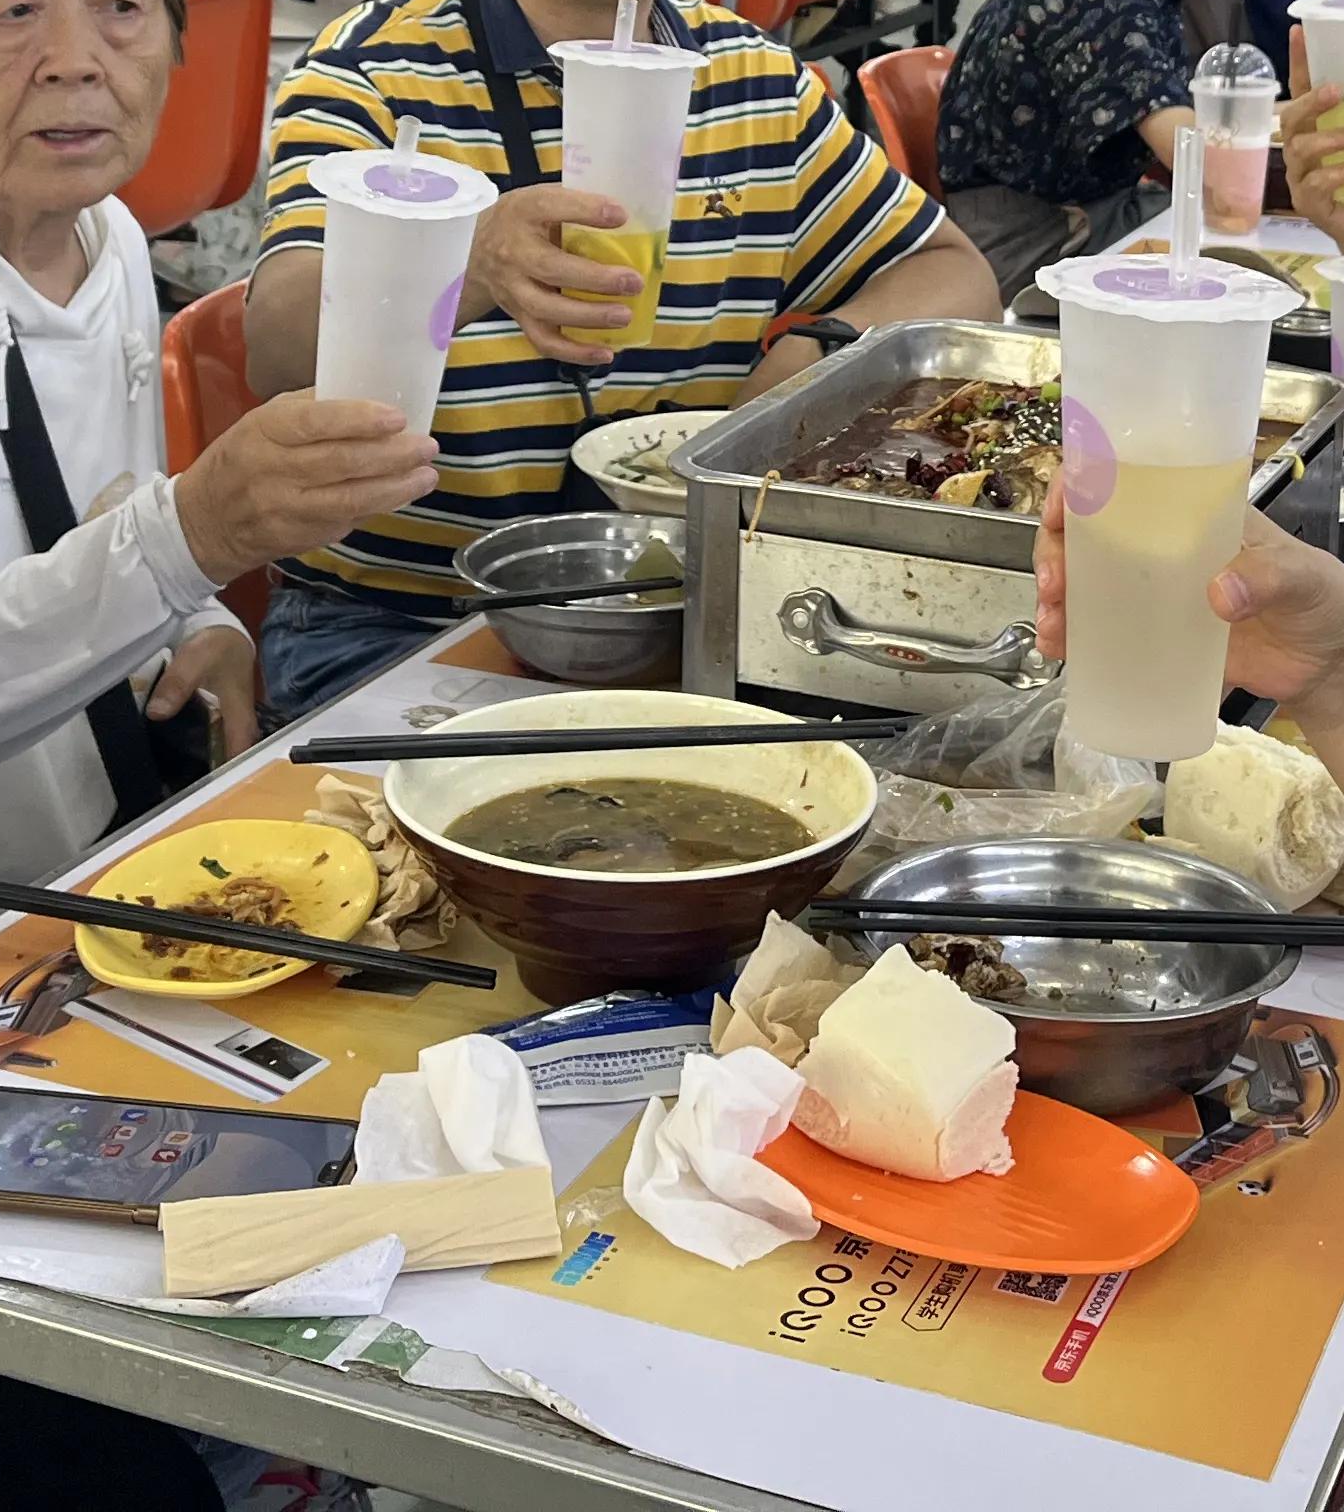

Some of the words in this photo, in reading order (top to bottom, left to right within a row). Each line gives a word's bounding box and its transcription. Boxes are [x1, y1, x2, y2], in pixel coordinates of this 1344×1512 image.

[643, 1060, 685, 1073] TECHNOLOG
[768, 1263, 853, 1343] iQOO
[833, 1232, 874, 1260] 京
[839, 1280, 898, 1337] iQOO
[1054, 1328, 1091, 1372] 京东手机
